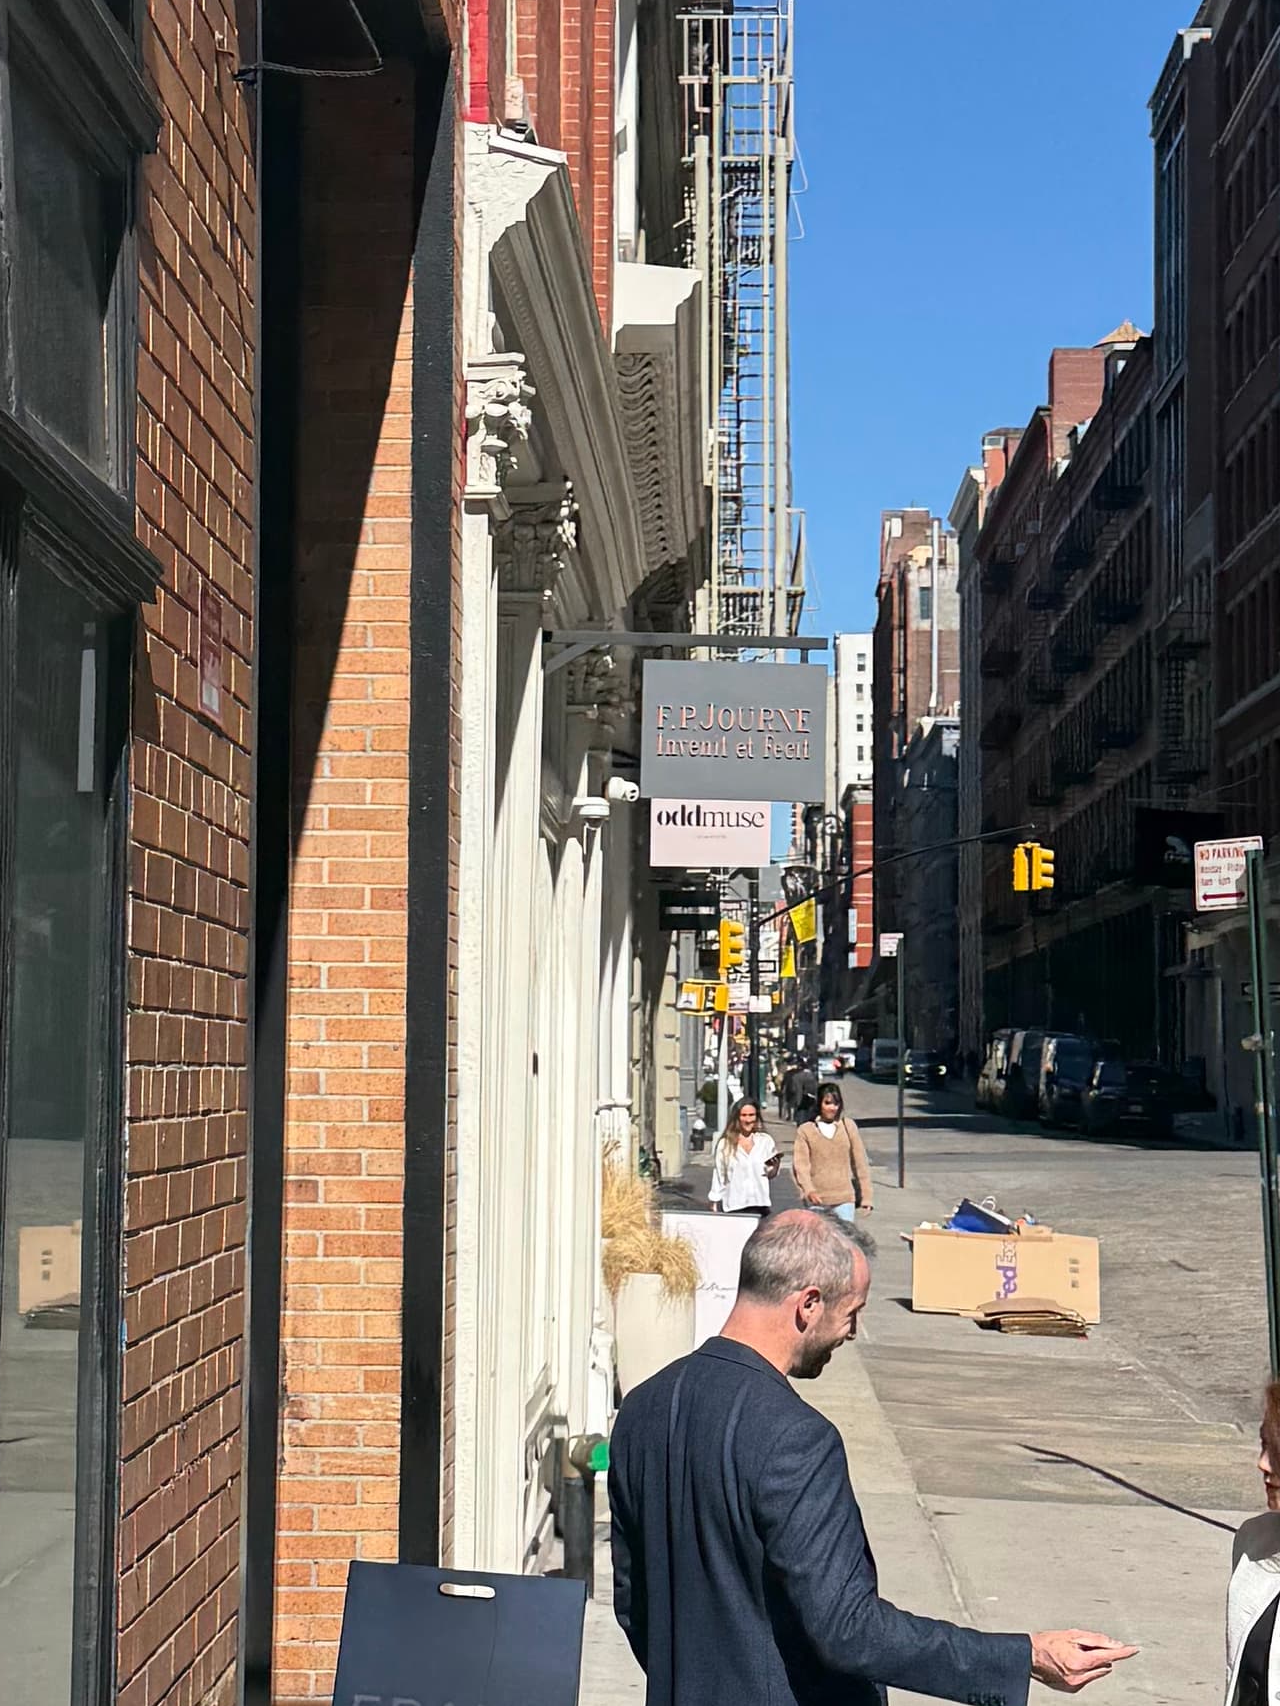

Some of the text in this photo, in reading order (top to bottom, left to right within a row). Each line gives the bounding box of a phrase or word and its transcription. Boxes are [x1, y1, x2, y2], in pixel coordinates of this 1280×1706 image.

[656, 732, 729, 759] Invenit
[736, 736, 755, 760] et
[656, 804, 766, 829] oddmuse
